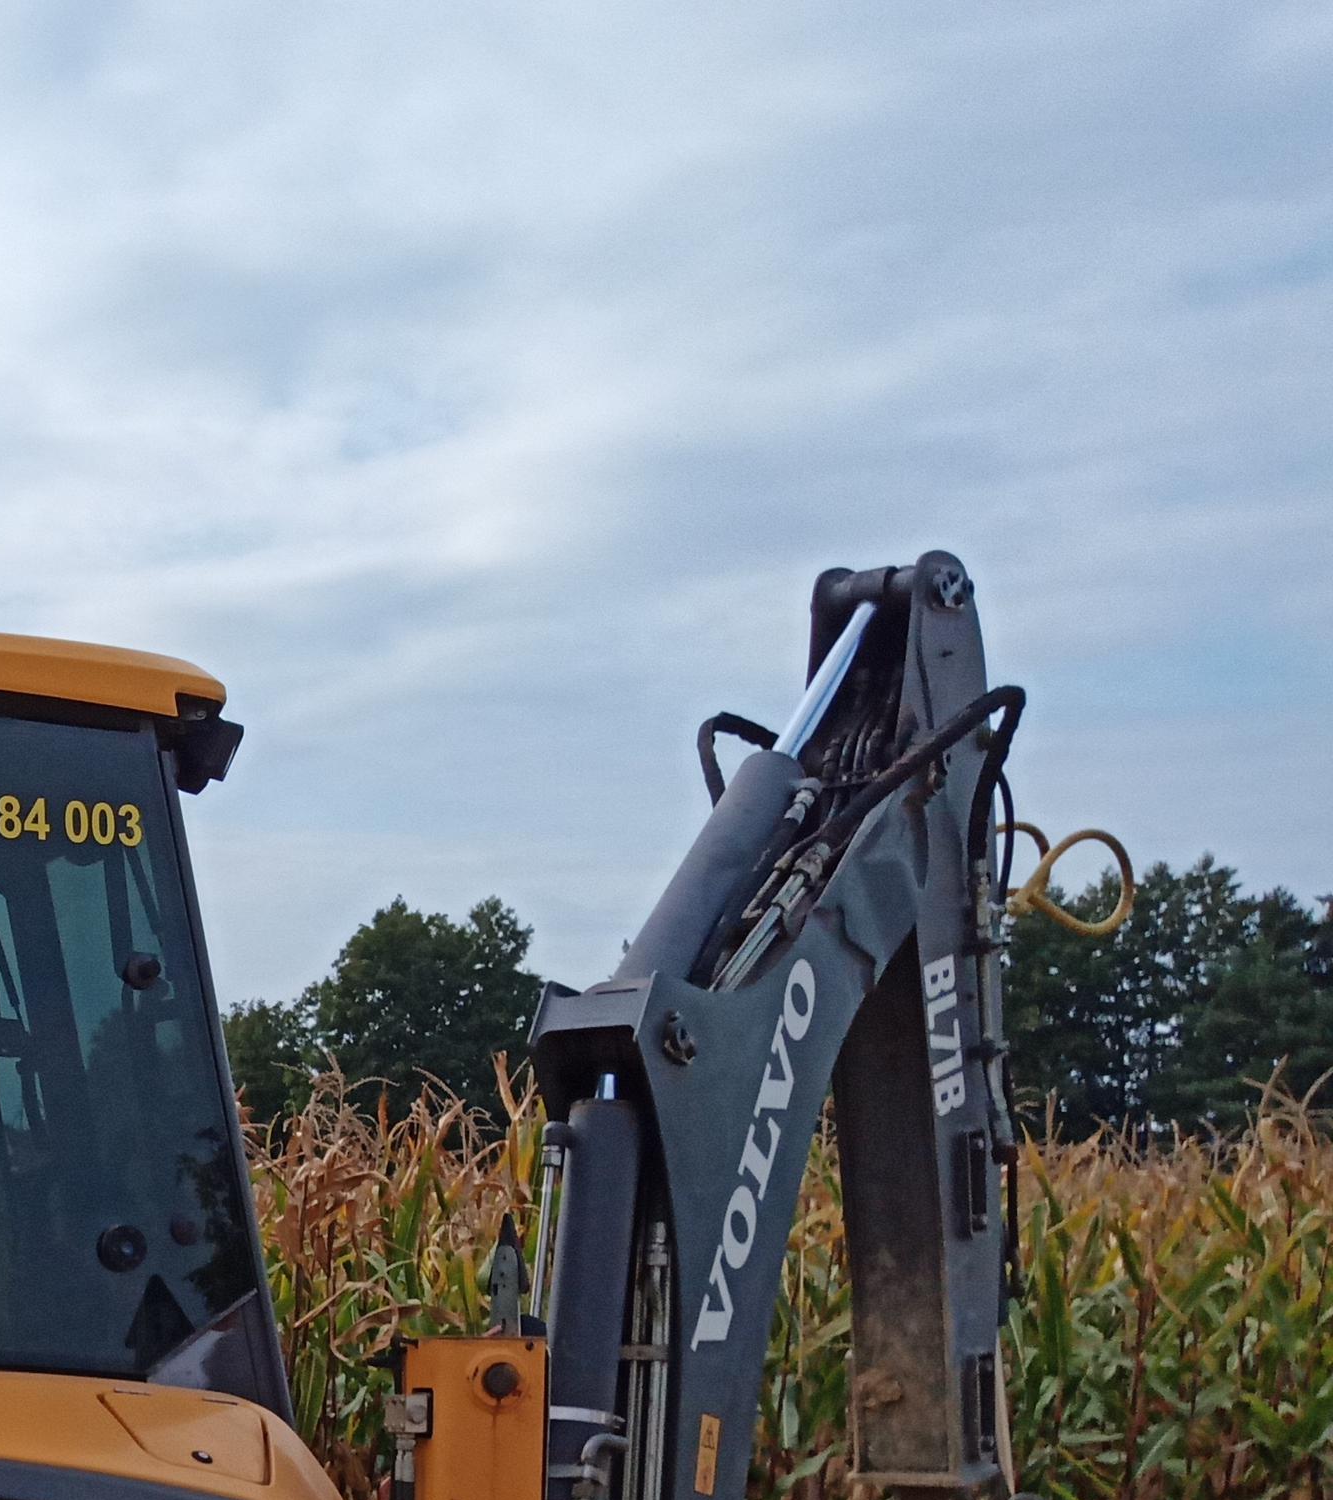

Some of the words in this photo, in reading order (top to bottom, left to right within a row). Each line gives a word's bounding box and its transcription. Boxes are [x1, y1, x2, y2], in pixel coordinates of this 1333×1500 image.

[64, 799, 144, 848] 003
[923, 953, 967, 1118] BL71B
[690, 957, 817, 1352] VOLVO
